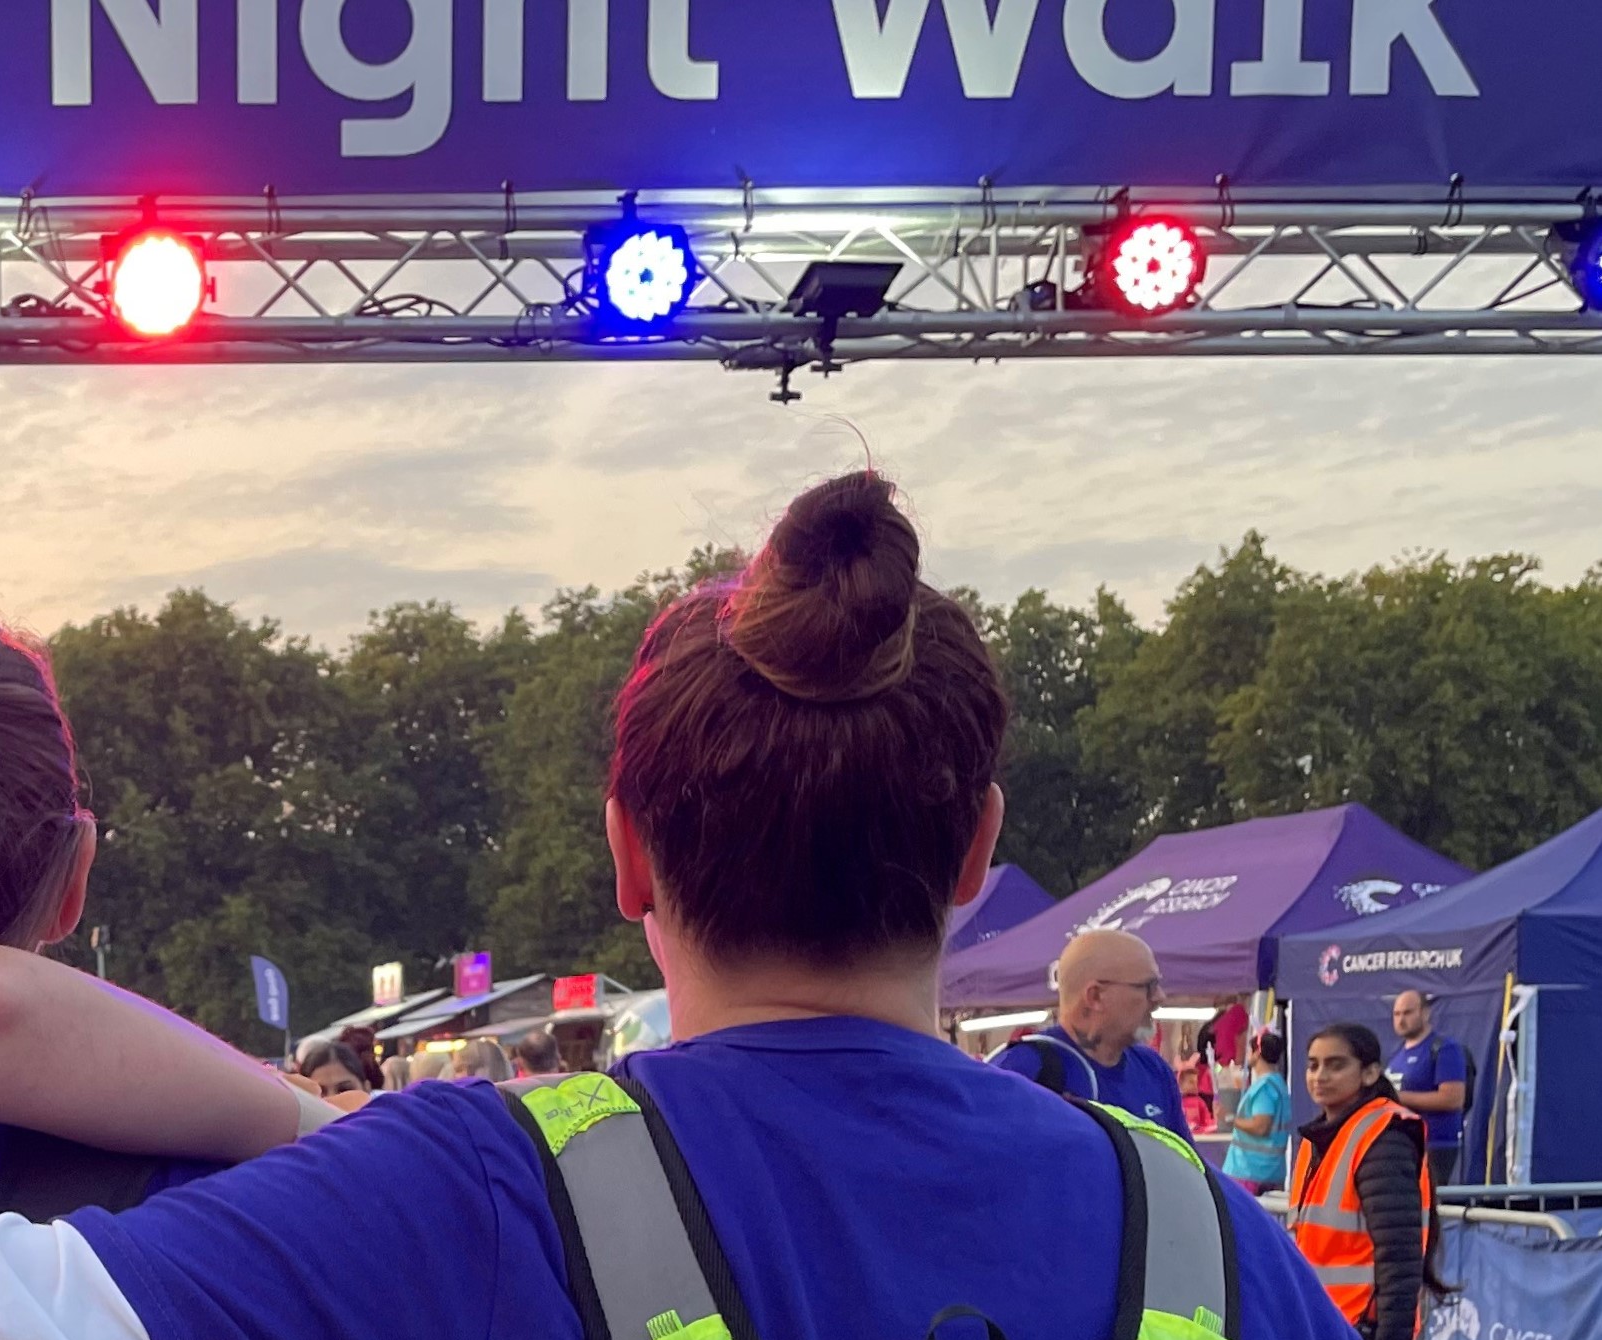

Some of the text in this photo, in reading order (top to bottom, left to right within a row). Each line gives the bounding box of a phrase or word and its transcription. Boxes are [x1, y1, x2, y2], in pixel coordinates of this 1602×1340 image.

[52, 0, 719, 156] Night
[831, 0, 1481, 98] Walk
[1343, 953, 1386, 973] CANCER
[1386, 950, 1444, 970] RESEARCH
